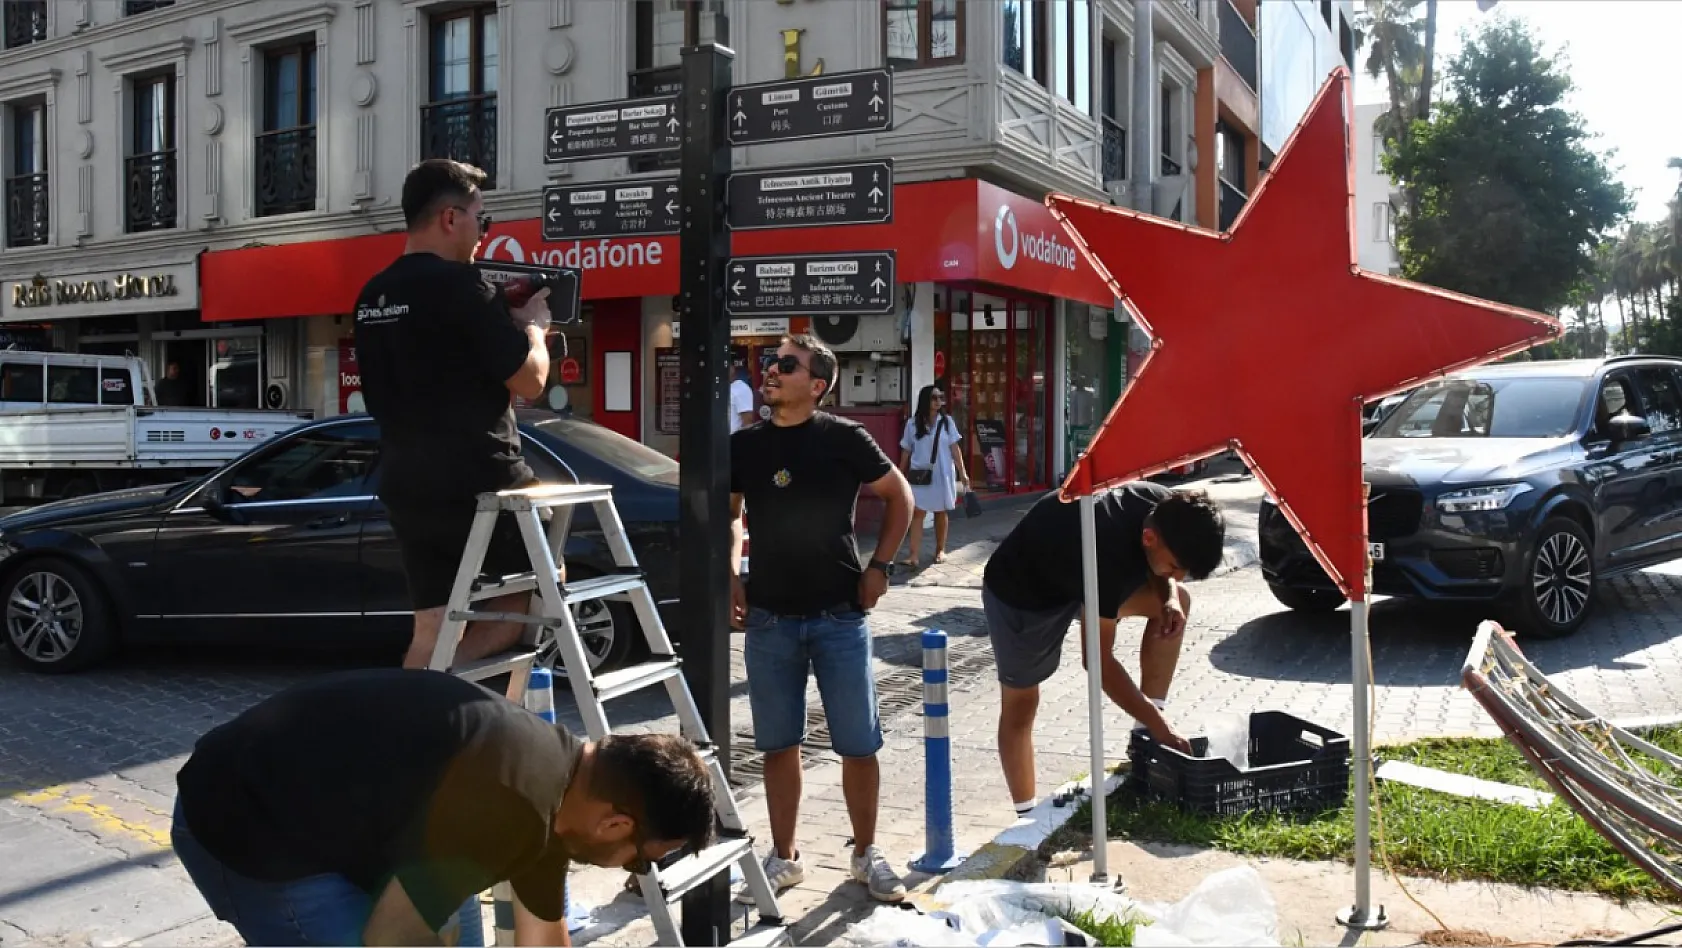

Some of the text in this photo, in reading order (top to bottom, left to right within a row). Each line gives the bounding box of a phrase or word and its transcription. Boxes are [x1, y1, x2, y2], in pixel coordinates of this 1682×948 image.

[815, 85, 849, 96] Gümrük
[768, 92, 793, 101] Liman
[816, 102, 848, 111] Customs
[773, 108, 789, 116] Port
[628, 120, 660, 130] Bar Street
[764, 179, 797, 189] Telmessos
[799, 176, 820, 186] Antik
[620, 189, 648, 199] Kayaköy
[758, 195, 793, 204] Telmessos
[796, 193, 823, 202] Ancient
[639, 209, 653, 218] City
[531, 239, 662, 269] vodafone
[1020, 231, 1076, 271] vodafone
[759, 265, 792, 275] Babadağ
[809, 262, 856, 273] Turizm Ofisi
[56, 279, 113, 305] ROYAL
[114, 273, 178, 300] HOTEL
